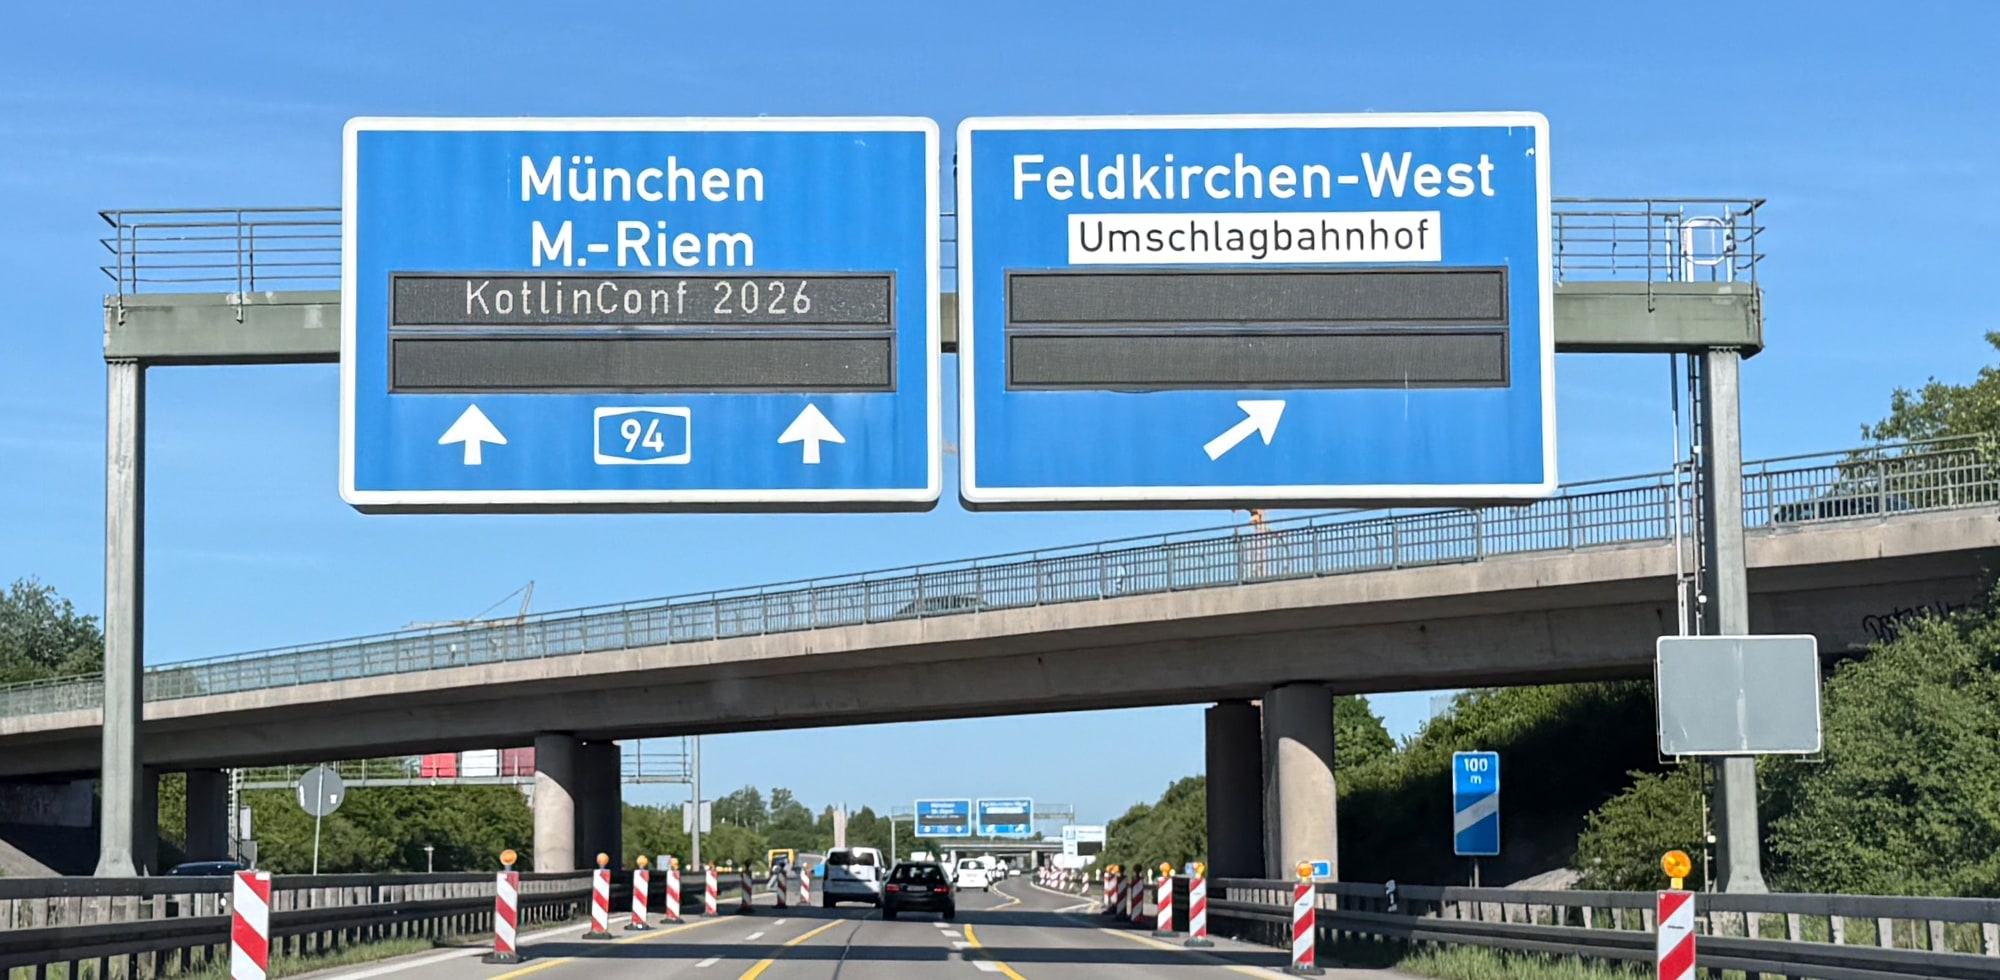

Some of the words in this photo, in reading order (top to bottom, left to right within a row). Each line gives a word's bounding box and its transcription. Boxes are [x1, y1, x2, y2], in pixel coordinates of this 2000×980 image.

[521, 155, 764, 202] München
[1013, 151, 1495, 201] Feldkirchen-West
[531, 219, 754, 267] M.-Riem
[1079, 218, 1430, 260] Umschlagbahnhof
[465, 280, 688, 314] KotlinConf
[713, 280, 812, 314] 2026
[620, 417, 665, 453] 94
[1465, 758, 1488, 772] 100
[1471, 775, 1482, 784] m
